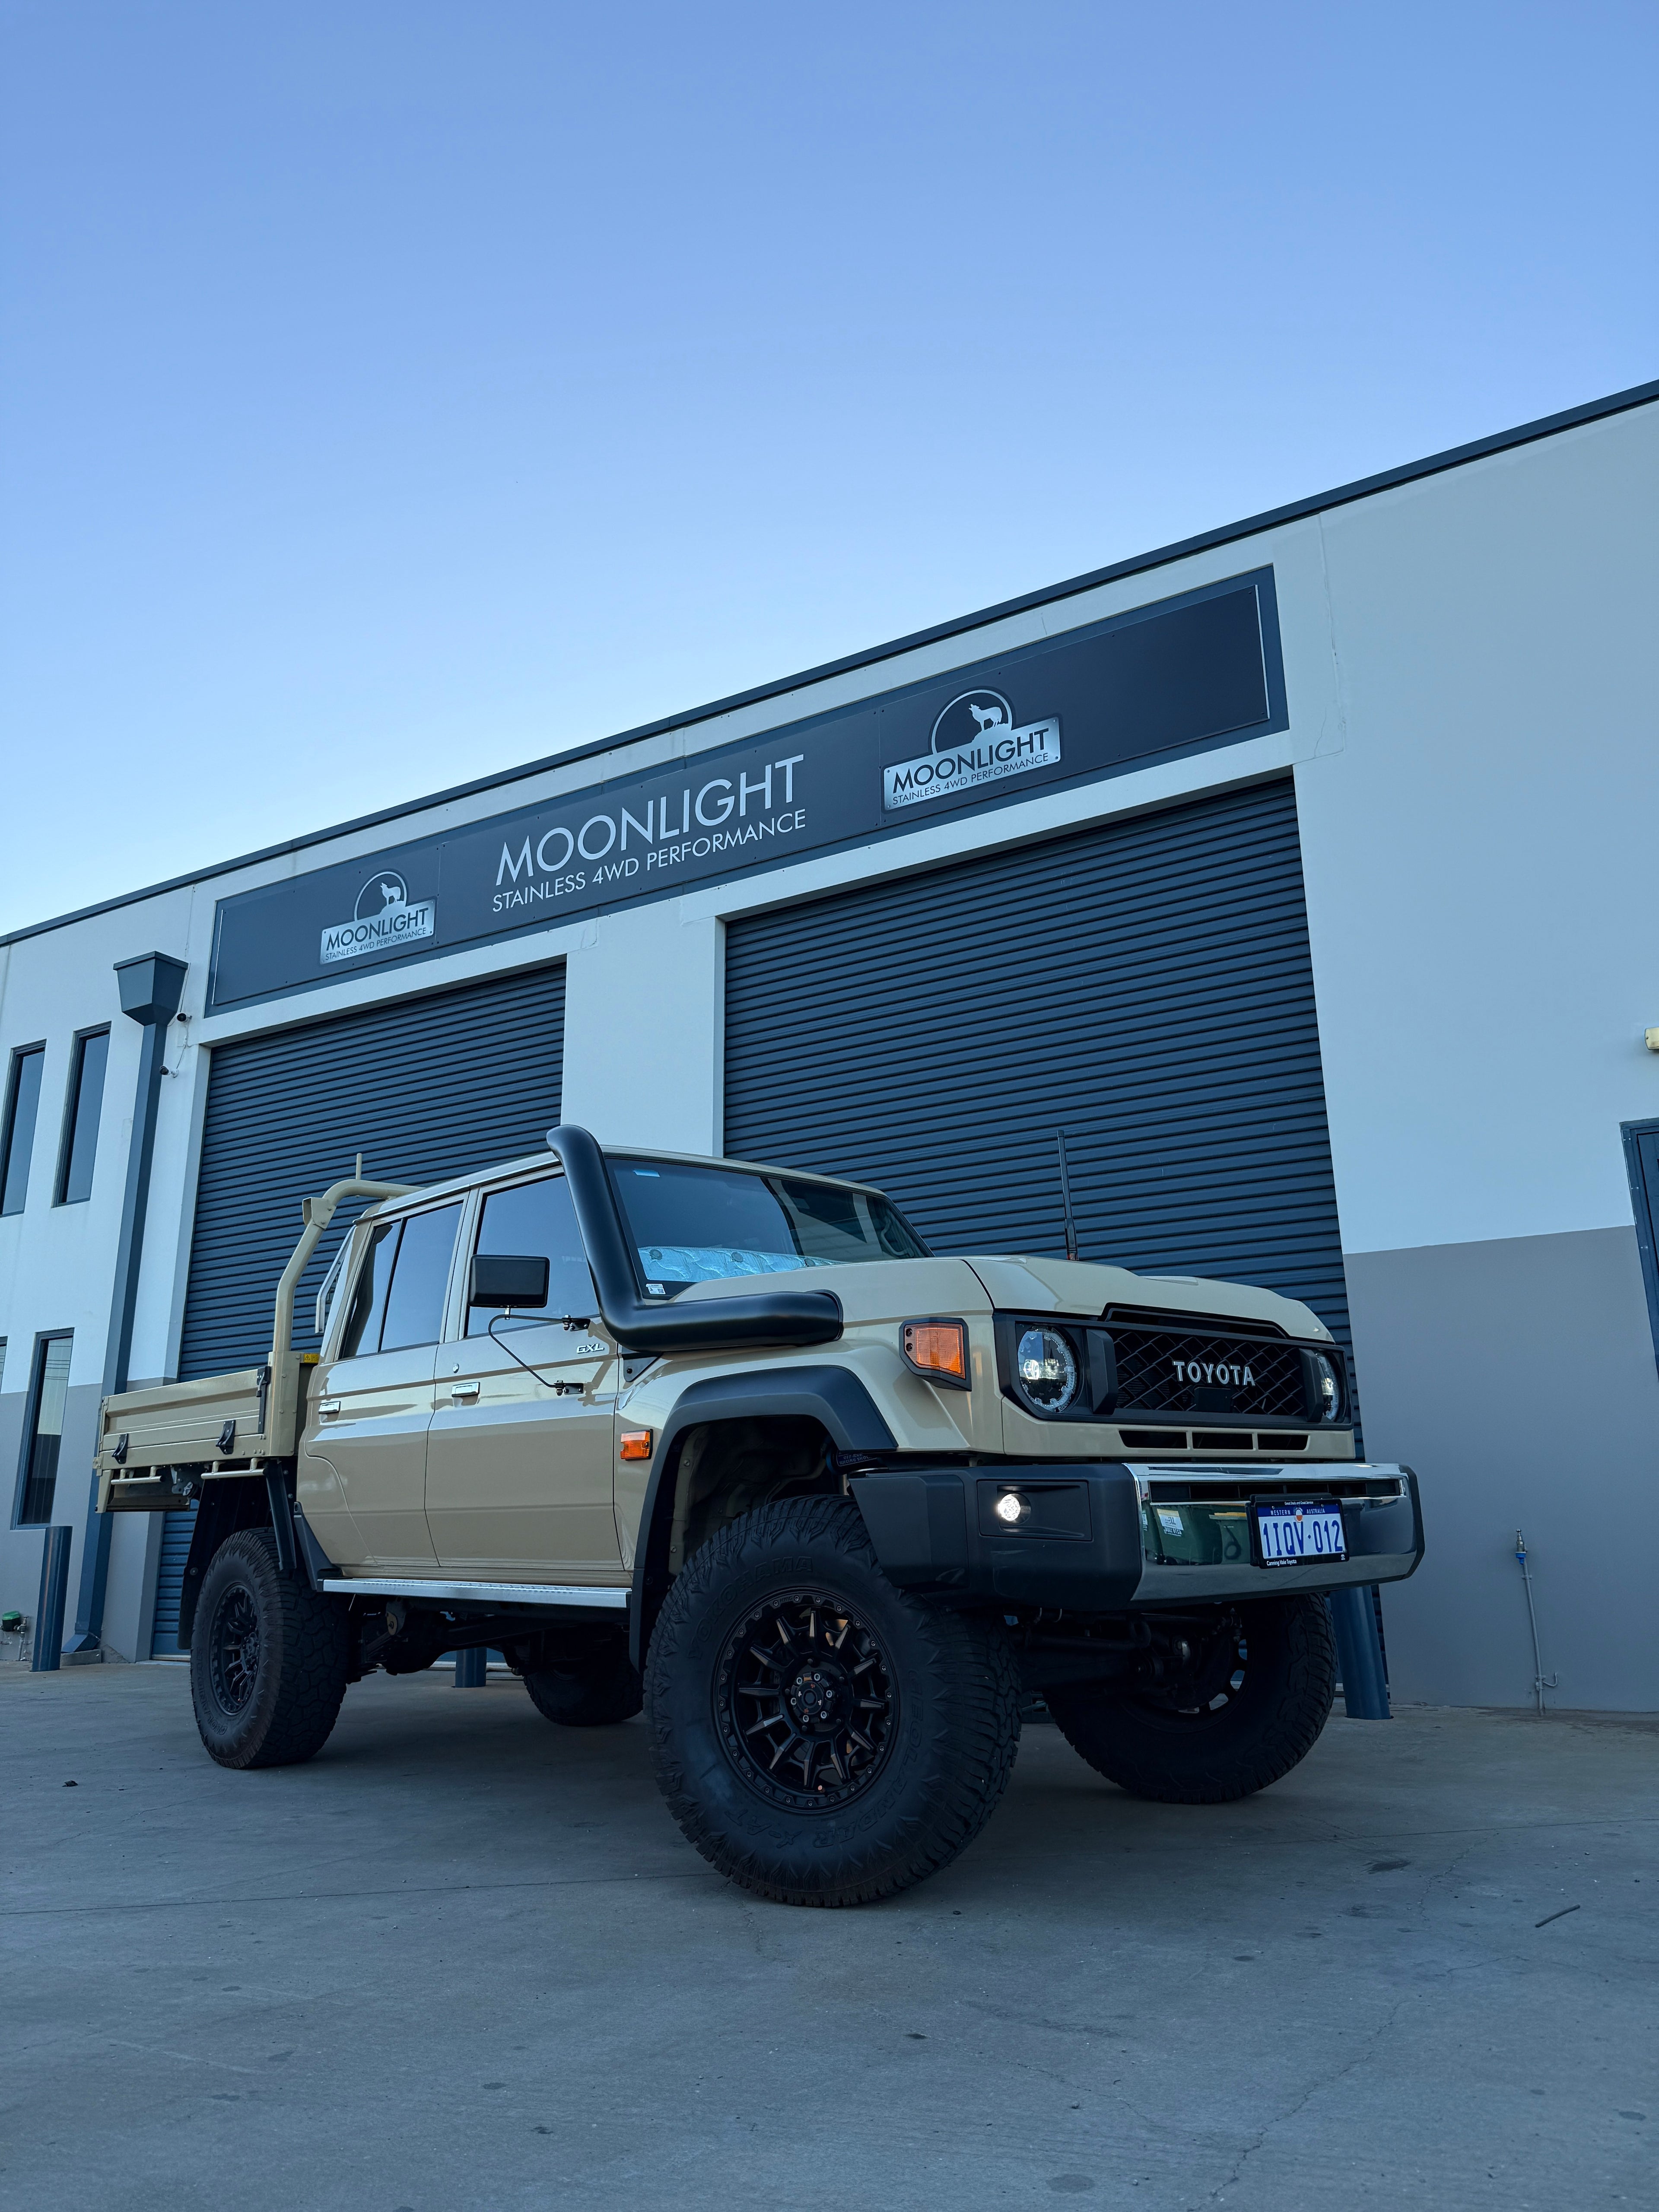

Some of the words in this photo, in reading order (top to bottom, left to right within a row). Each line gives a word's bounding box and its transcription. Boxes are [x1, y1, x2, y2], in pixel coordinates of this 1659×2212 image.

[893, 728, 1049, 794] MOONLIGHT
[893, 784, 941, 805] STAINLESS
[944, 777, 967, 790] 4WD
[971, 753, 1049, 783] PERFORMANCE
[496, 754, 804, 886] MOONLIGHT
[493, 871, 586, 912] STAINLESS
[592, 858, 639, 885] 4WD
[647, 809, 806, 871] PERFORMANCE
[325, 947, 357, 960] STAINLESS
[359, 939, 374, 951] 4WD
[376, 928, 426, 947] PERFORMANCE
[326, 908, 429, 951] MOONLIGHT
[576, 1343, 604, 1354] GXL
[1173, 1360, 1255, 1386] TOYOTA
[687, 1556, 813, 1659] YOKOHAMA
